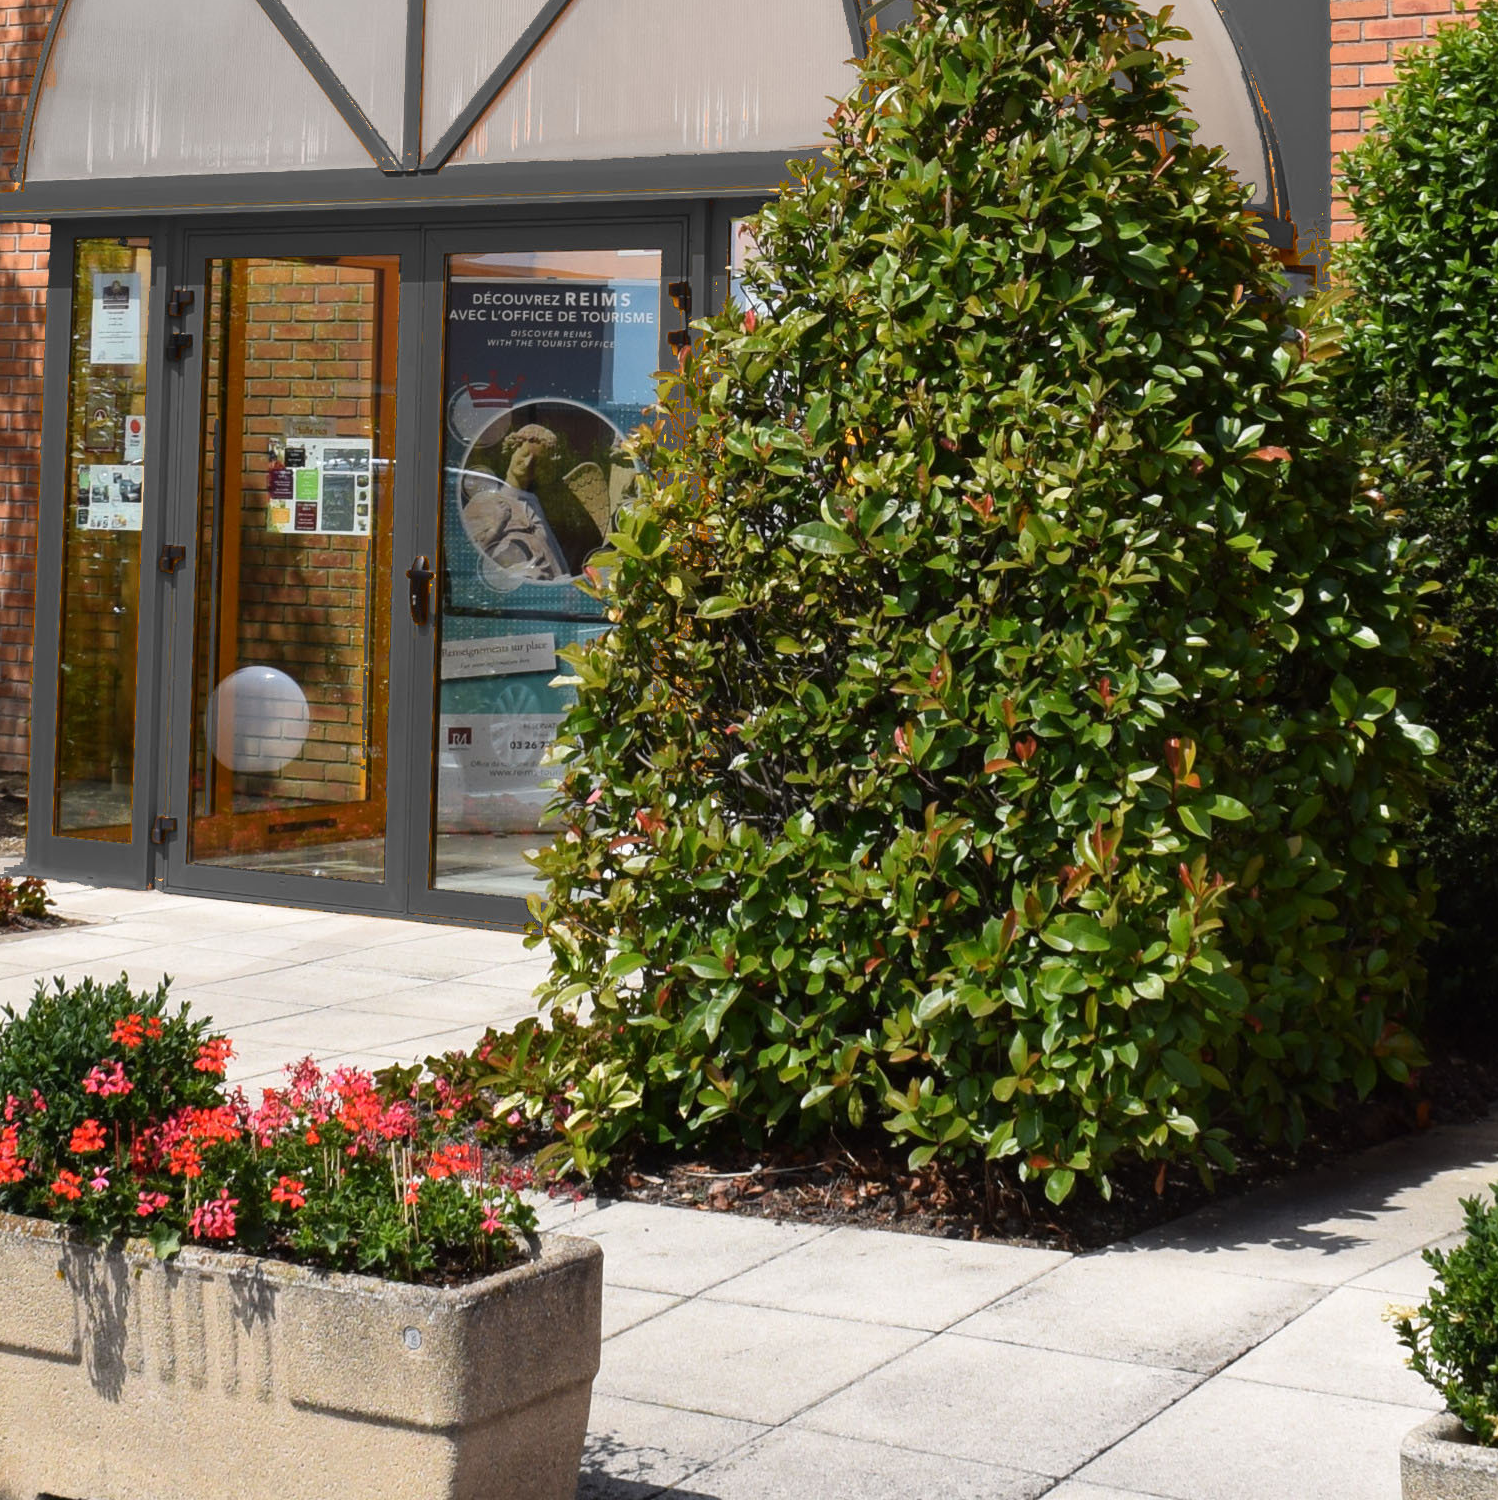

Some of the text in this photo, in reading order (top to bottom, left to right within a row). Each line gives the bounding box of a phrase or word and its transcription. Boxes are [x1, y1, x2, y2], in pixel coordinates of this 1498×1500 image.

[472, 291, 631, 307] DÉCOUVREZ REIMS
[449, 309, 654, 324] AVEC L'OFFICE DE TOURISME
[510, 329, 593, 338] DISCOVER REIMS
[487, 338, 615, 349] WITH THE TOURIST OFFICE
[509, 741, 522, 749] 03
[524, 741, 537, 749] 26
